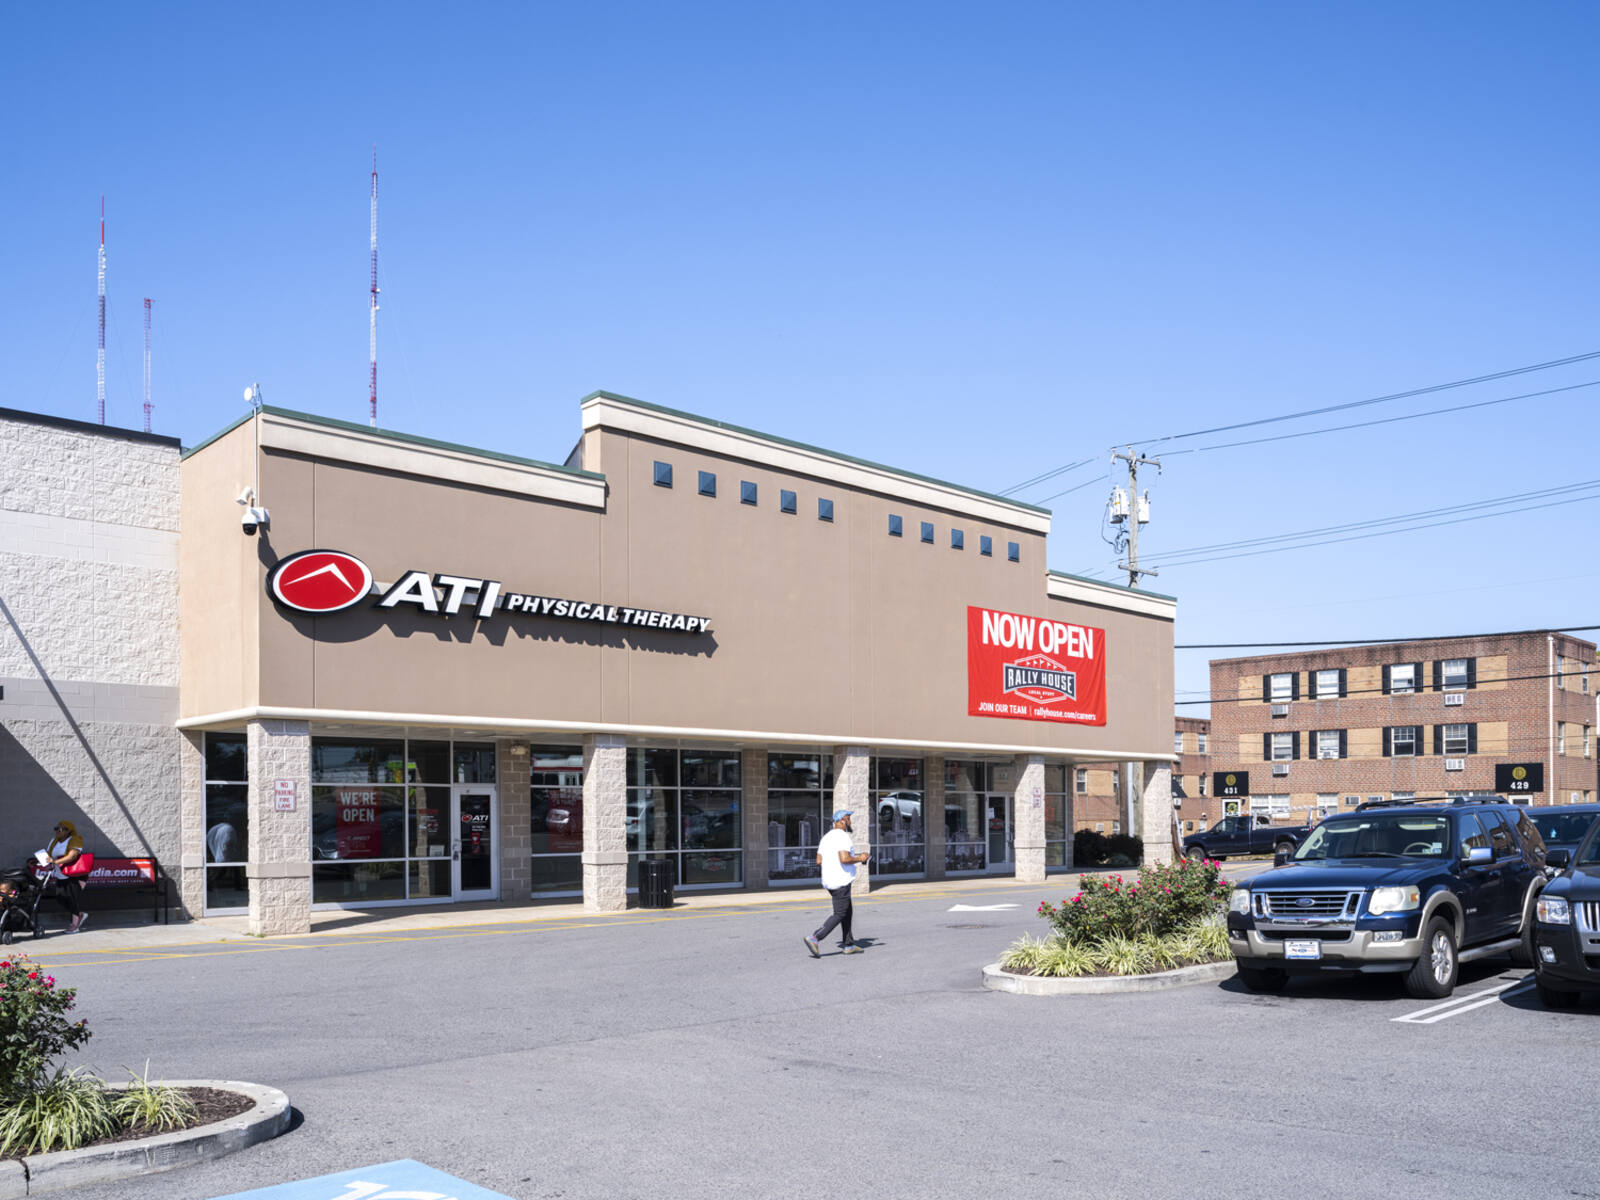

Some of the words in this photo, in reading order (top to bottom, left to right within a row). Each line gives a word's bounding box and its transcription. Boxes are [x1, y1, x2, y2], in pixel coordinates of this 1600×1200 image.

[379, 571, 502, 618] ATI
[506, 594, 620, 623] PHYSICAL
[622, 608, 712, 633] THERAPY
[982, 610, 1035, 651] NOW
[1038, 620, 1094, 660] OPEN
[1007, 668, 1039, 688] RALLY
[1041, 672, 1073, 694] HOUSE
[978, 702, 994, 712] JOIN
[994, 703, 1009, 713] OUR
[1009, 704, 1027, 715] TEAM
[1510, 781, 1529, 790] 429
[340, 791, 377, 806] WE'RE
[343, 808, 375, 822] OPEN
